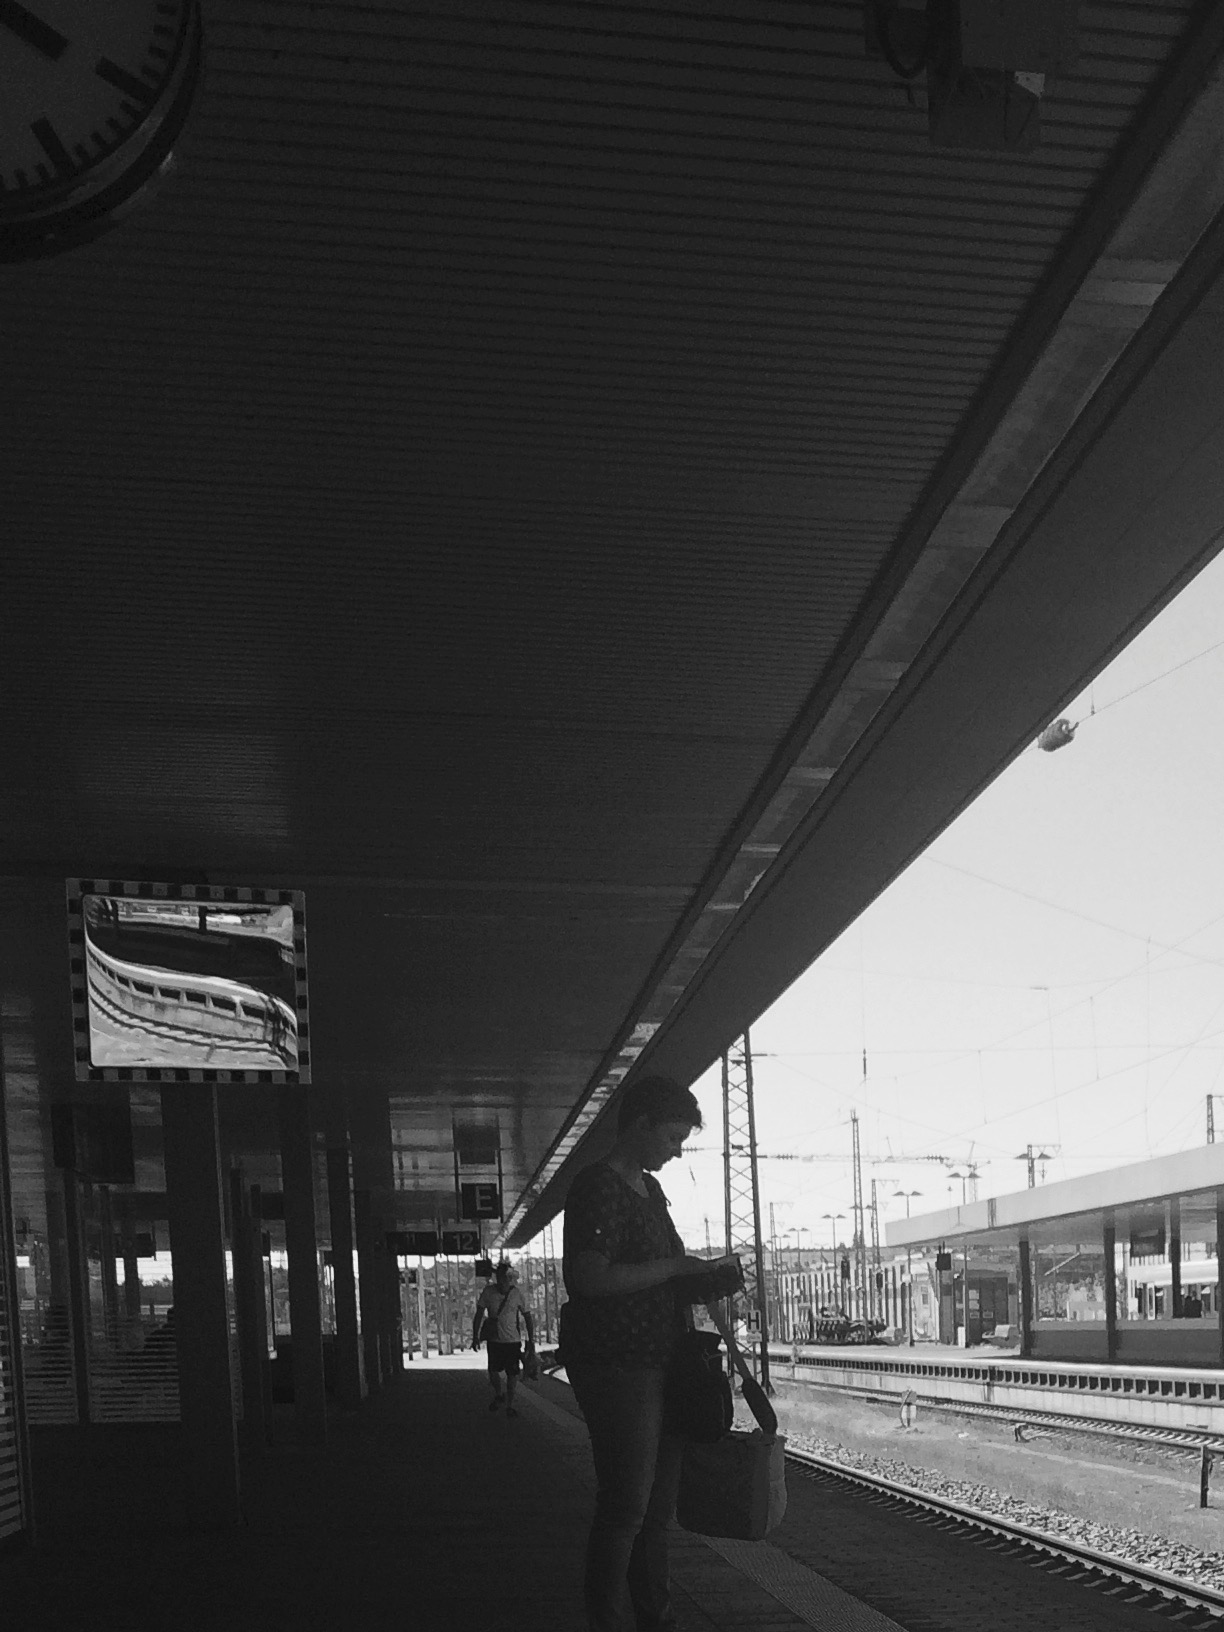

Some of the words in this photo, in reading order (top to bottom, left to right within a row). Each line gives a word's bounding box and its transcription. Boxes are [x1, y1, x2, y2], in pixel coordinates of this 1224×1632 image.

[475, 1185, 493, 1211] E
[453, 1232, 474, 1251] 12
[748, 1312, 759, 1330] H
